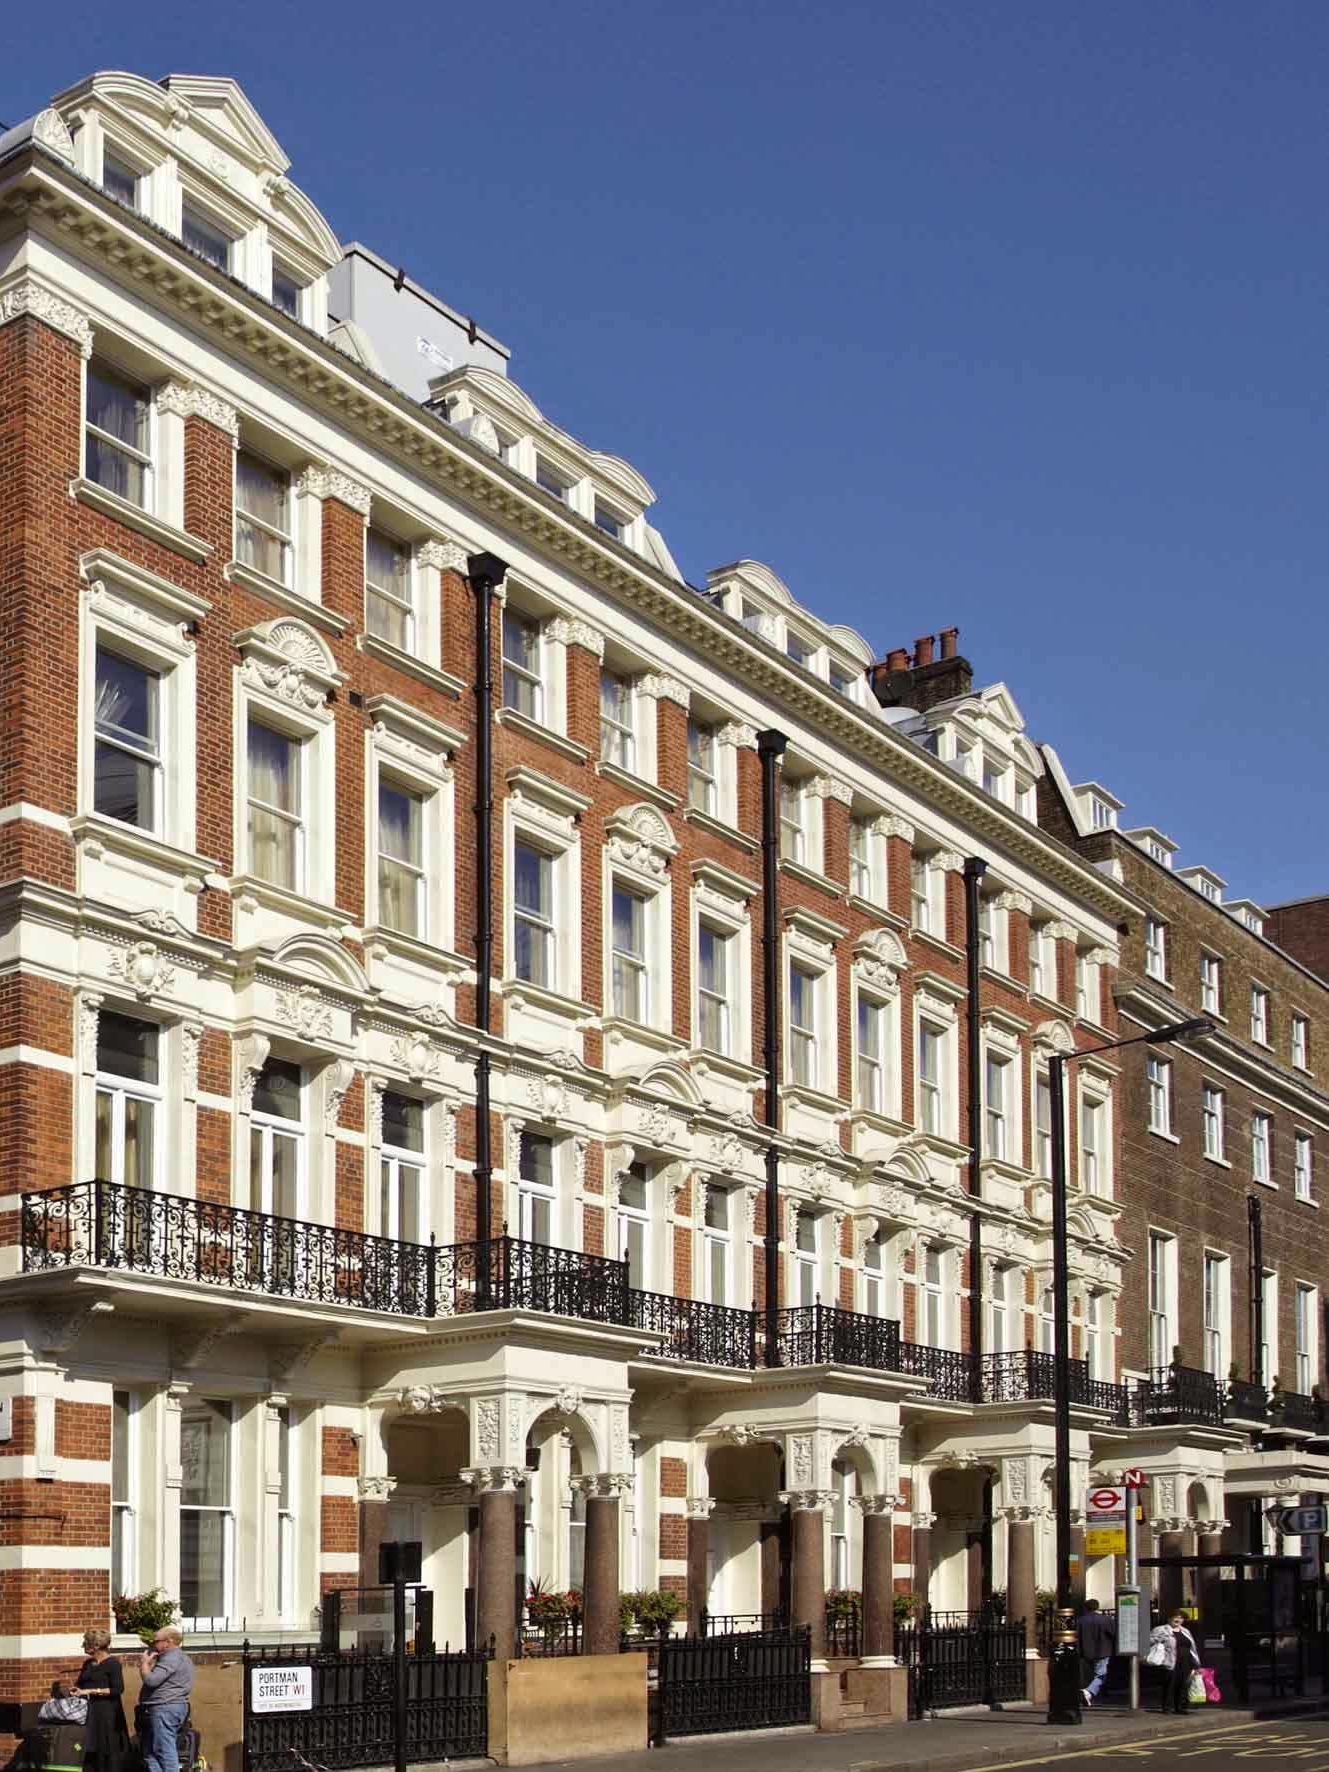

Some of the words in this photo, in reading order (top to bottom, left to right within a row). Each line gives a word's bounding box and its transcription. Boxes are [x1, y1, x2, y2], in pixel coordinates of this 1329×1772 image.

[1125, 1471, 1140, 1484] N
[1303, 1511, 1318, 1529] P
[259, 1672, 298, 1684] PORTMAN
[259, 1685, 288, 1697] STREET
[293, 1684, 305, 1696] W1
